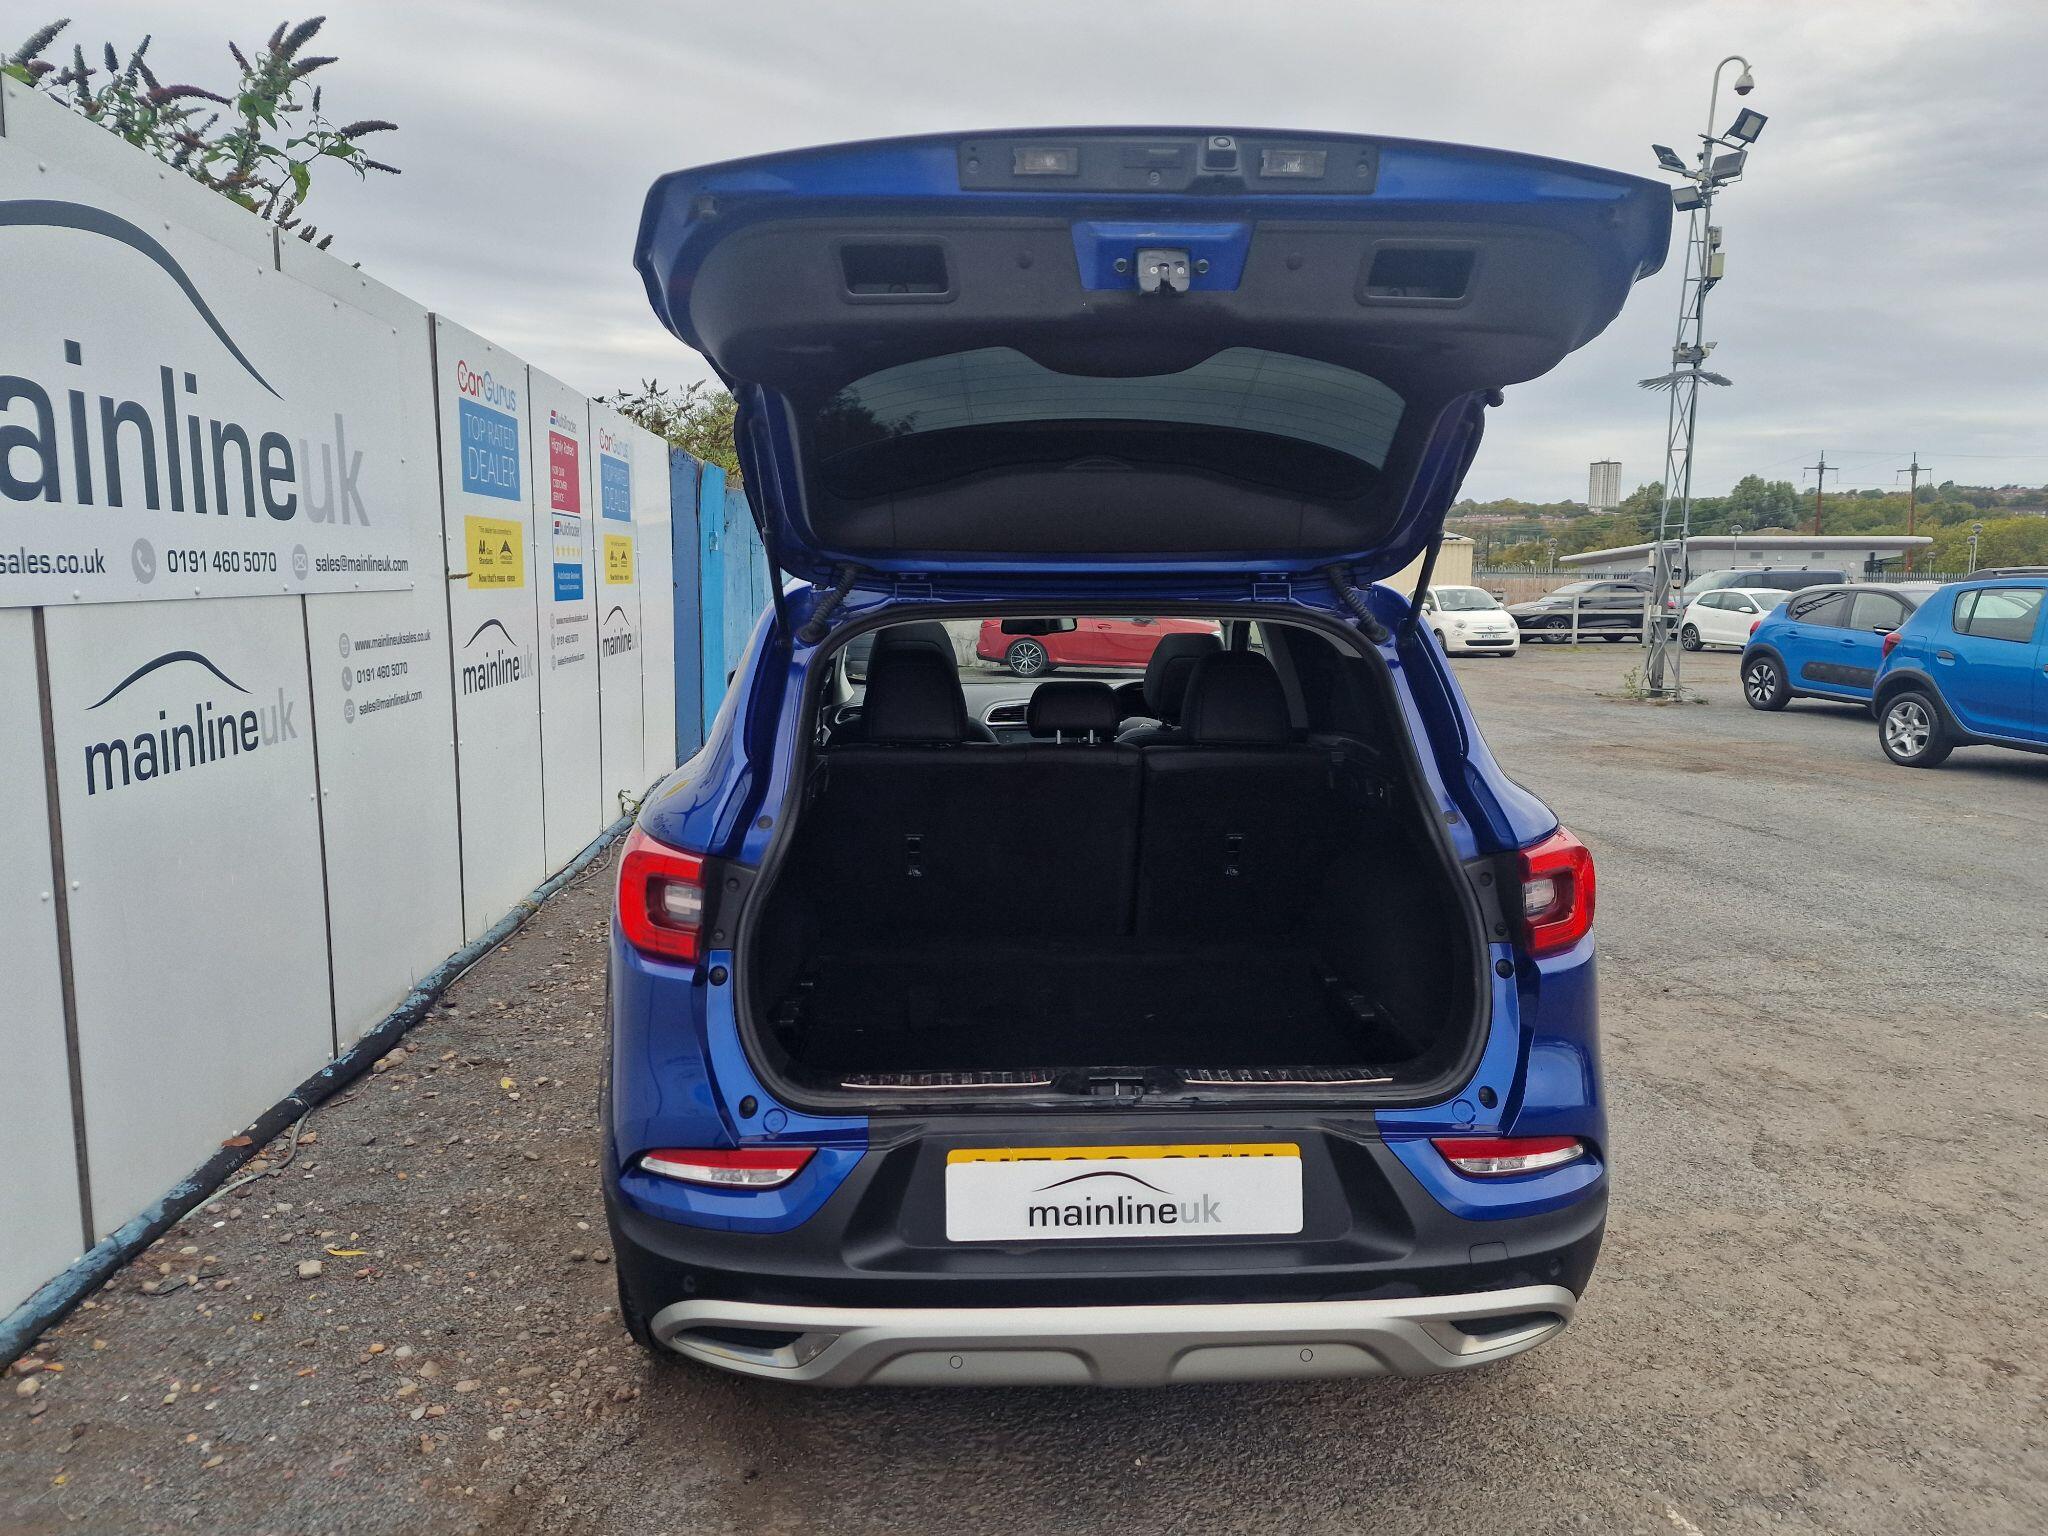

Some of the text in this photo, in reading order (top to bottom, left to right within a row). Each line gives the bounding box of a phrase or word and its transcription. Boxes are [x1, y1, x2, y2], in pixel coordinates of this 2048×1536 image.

[457, 360, 516, 412] CarGurus
[465, 413, 515, 451] TOP RATED
[468, 446, 517, 488] DEALER
[167, 550, 207, 573] 0191
[212, 551, 239, 572] 460
[243, 551, 277, 572] 5070
[315, 553, 409, 572] sales@mainlineuk.com
[354, 628, 431, 651] www.mainlineuksales.co.uk
[356, 661, 408, 684] 0191 460 5070
[359, 690, 423, 716] sales@mainlineuk.com
